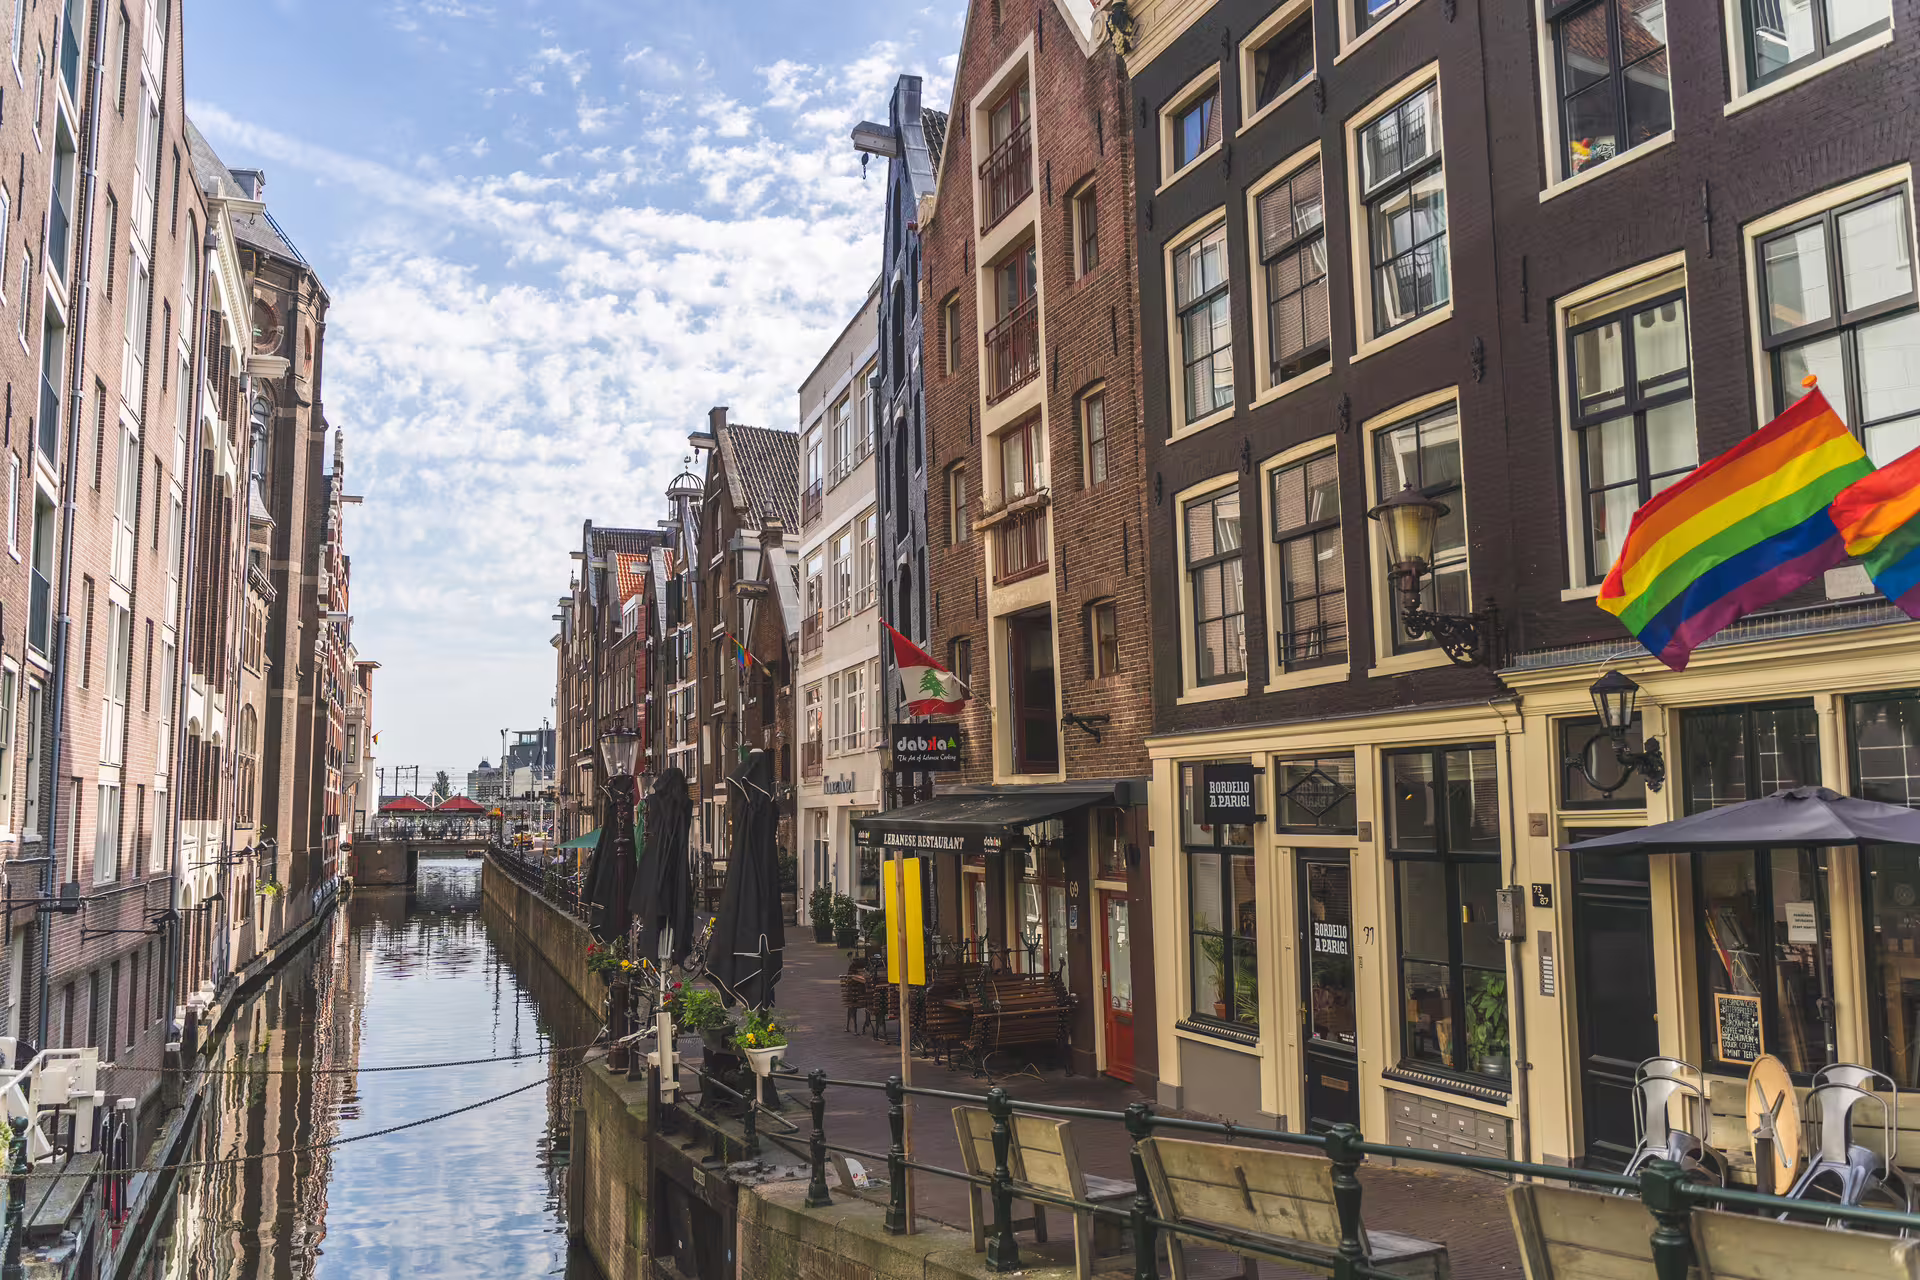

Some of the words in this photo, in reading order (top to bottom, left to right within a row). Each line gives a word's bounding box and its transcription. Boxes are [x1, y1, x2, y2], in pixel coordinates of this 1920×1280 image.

[897, 736, 947, 751] dabka
[897, 754, 907, 762] The
[916, 754, 921, 763] of
[939, 753, 957, 762] Cooking
[1209, 781, 1250, 794] BORDELLO
[1209, 795, 1217, 808] A
[1218, 795, 1250, 808] PARIGI
[883, 833, 917, 847] LEBANESE
[918, 836, 965, 850] RESTAURANT
[1070, 880, 1079, 898] 69
[1533, 885, 1542, 893] 73
[1314, 922, 1348, 939] BORDELLO
[1314, 937, 1322, 952] A
[1321, 938, 1348, 955] PARIGI
[1721, 1026, 1738, 1035] COFFEE
[1744, 1028, 1755, 1036] TEA
[1738, 1042, 1757, 1051] COFFEE
[1727, 1048, 1741, 1058] MINT
[1743, 1049, 1754, 1059] TEA
